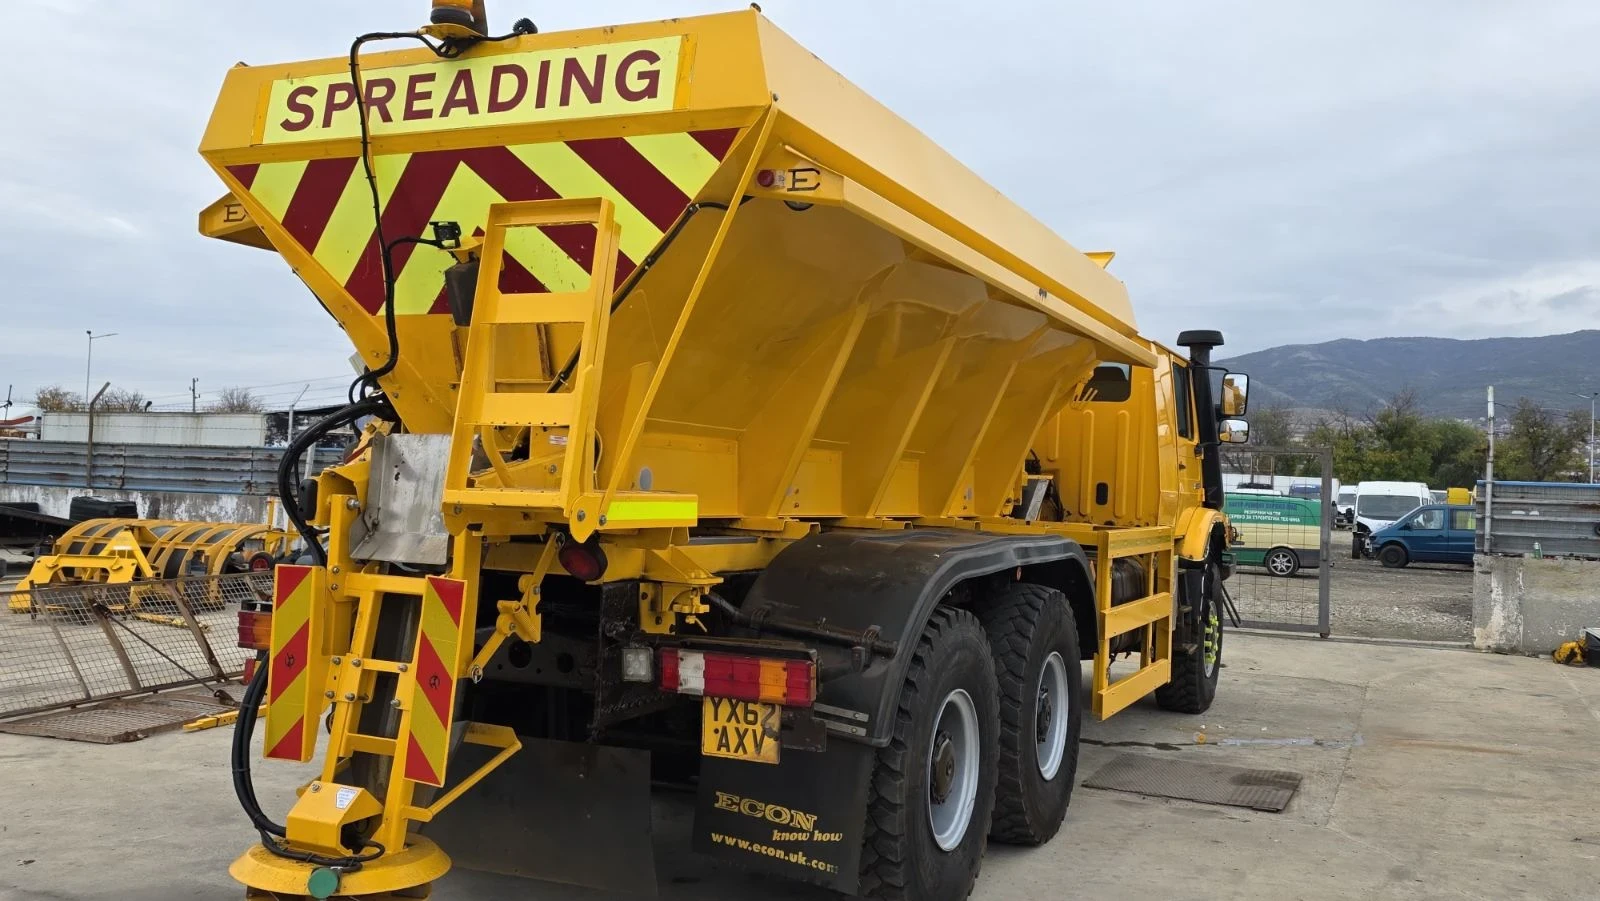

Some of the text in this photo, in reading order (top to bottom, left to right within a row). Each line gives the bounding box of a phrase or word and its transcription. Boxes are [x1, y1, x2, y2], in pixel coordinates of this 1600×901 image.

[280, 49, 661, 132] SPREADING
[709, 696, 777, 729] YX62
[716, 725, 767, 756] AXV
[713, 791, 818, 832] ECON
[771, 829, 843, 842] know how
